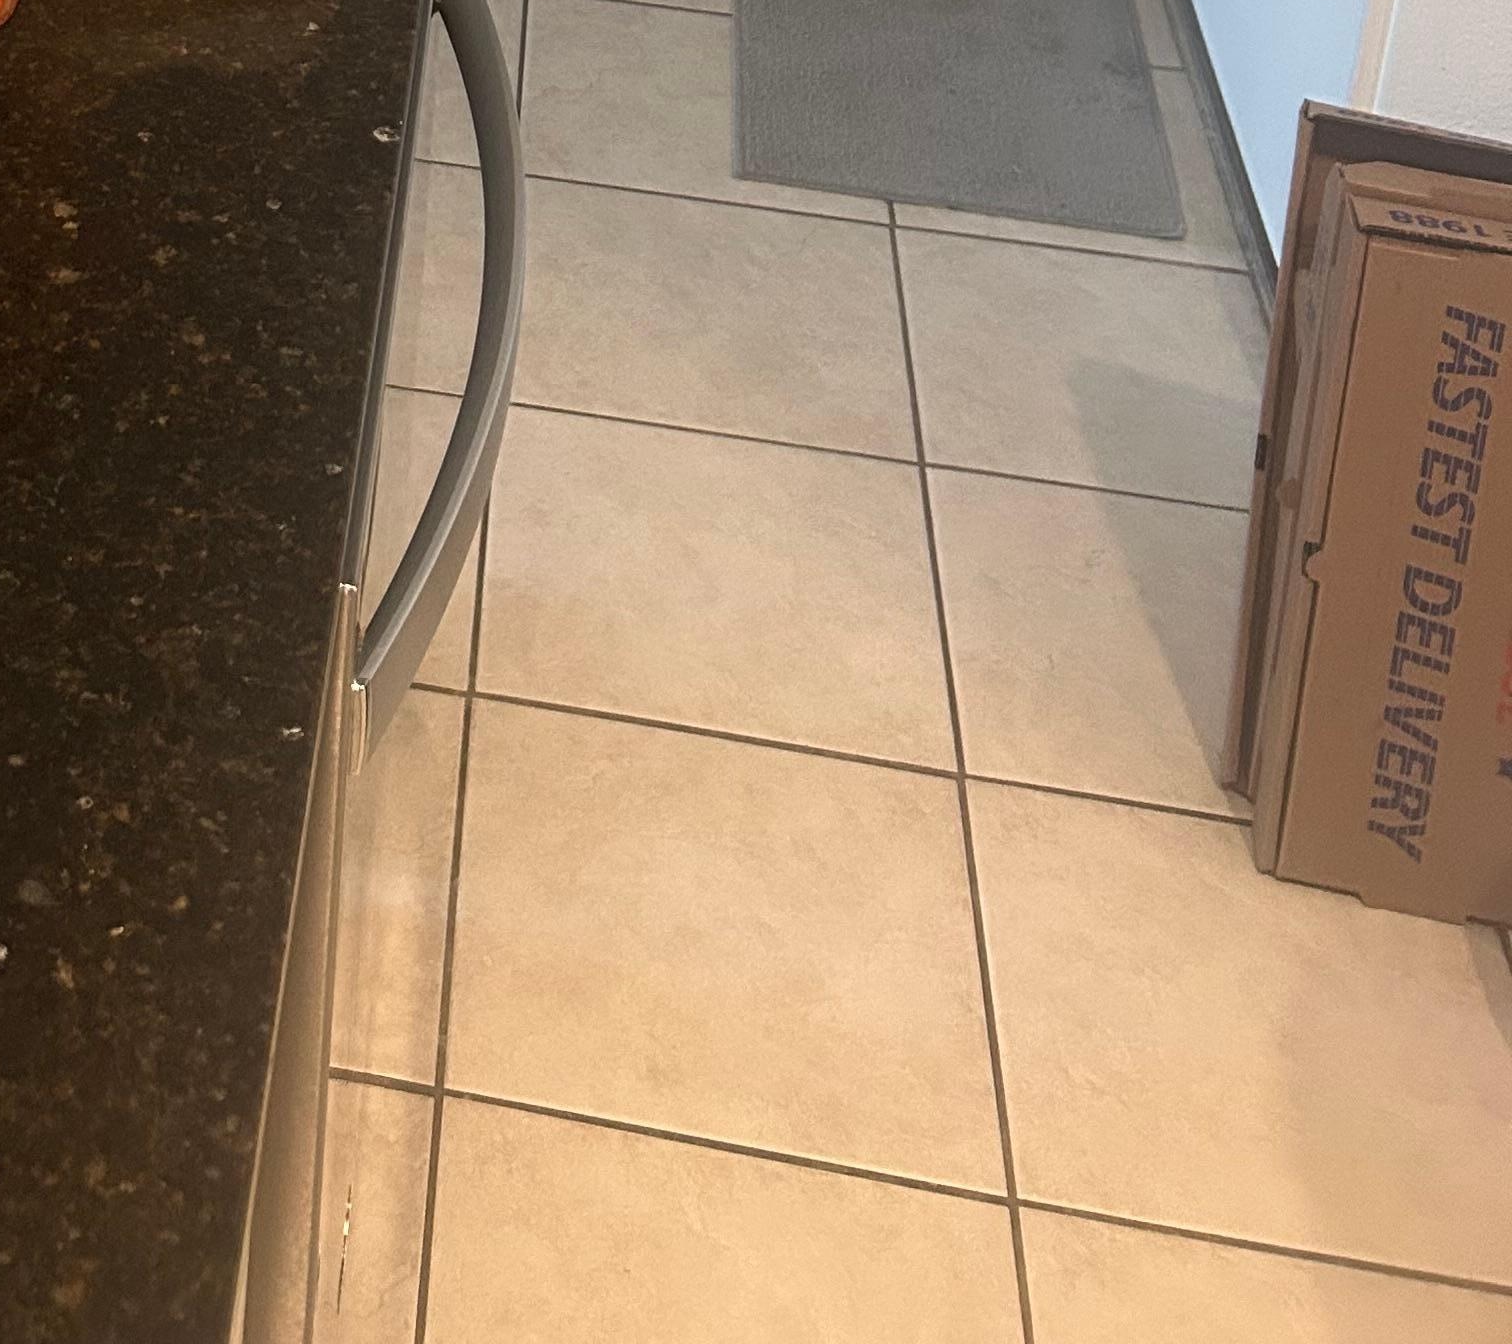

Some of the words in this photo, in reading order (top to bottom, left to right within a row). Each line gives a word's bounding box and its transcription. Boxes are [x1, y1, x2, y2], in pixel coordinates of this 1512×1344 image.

[1389, 209, 1491, 238] 1988
[1410, 304, 1507, 566] FASTEST
[1366, 562, 1464, 865] DELIVERY
